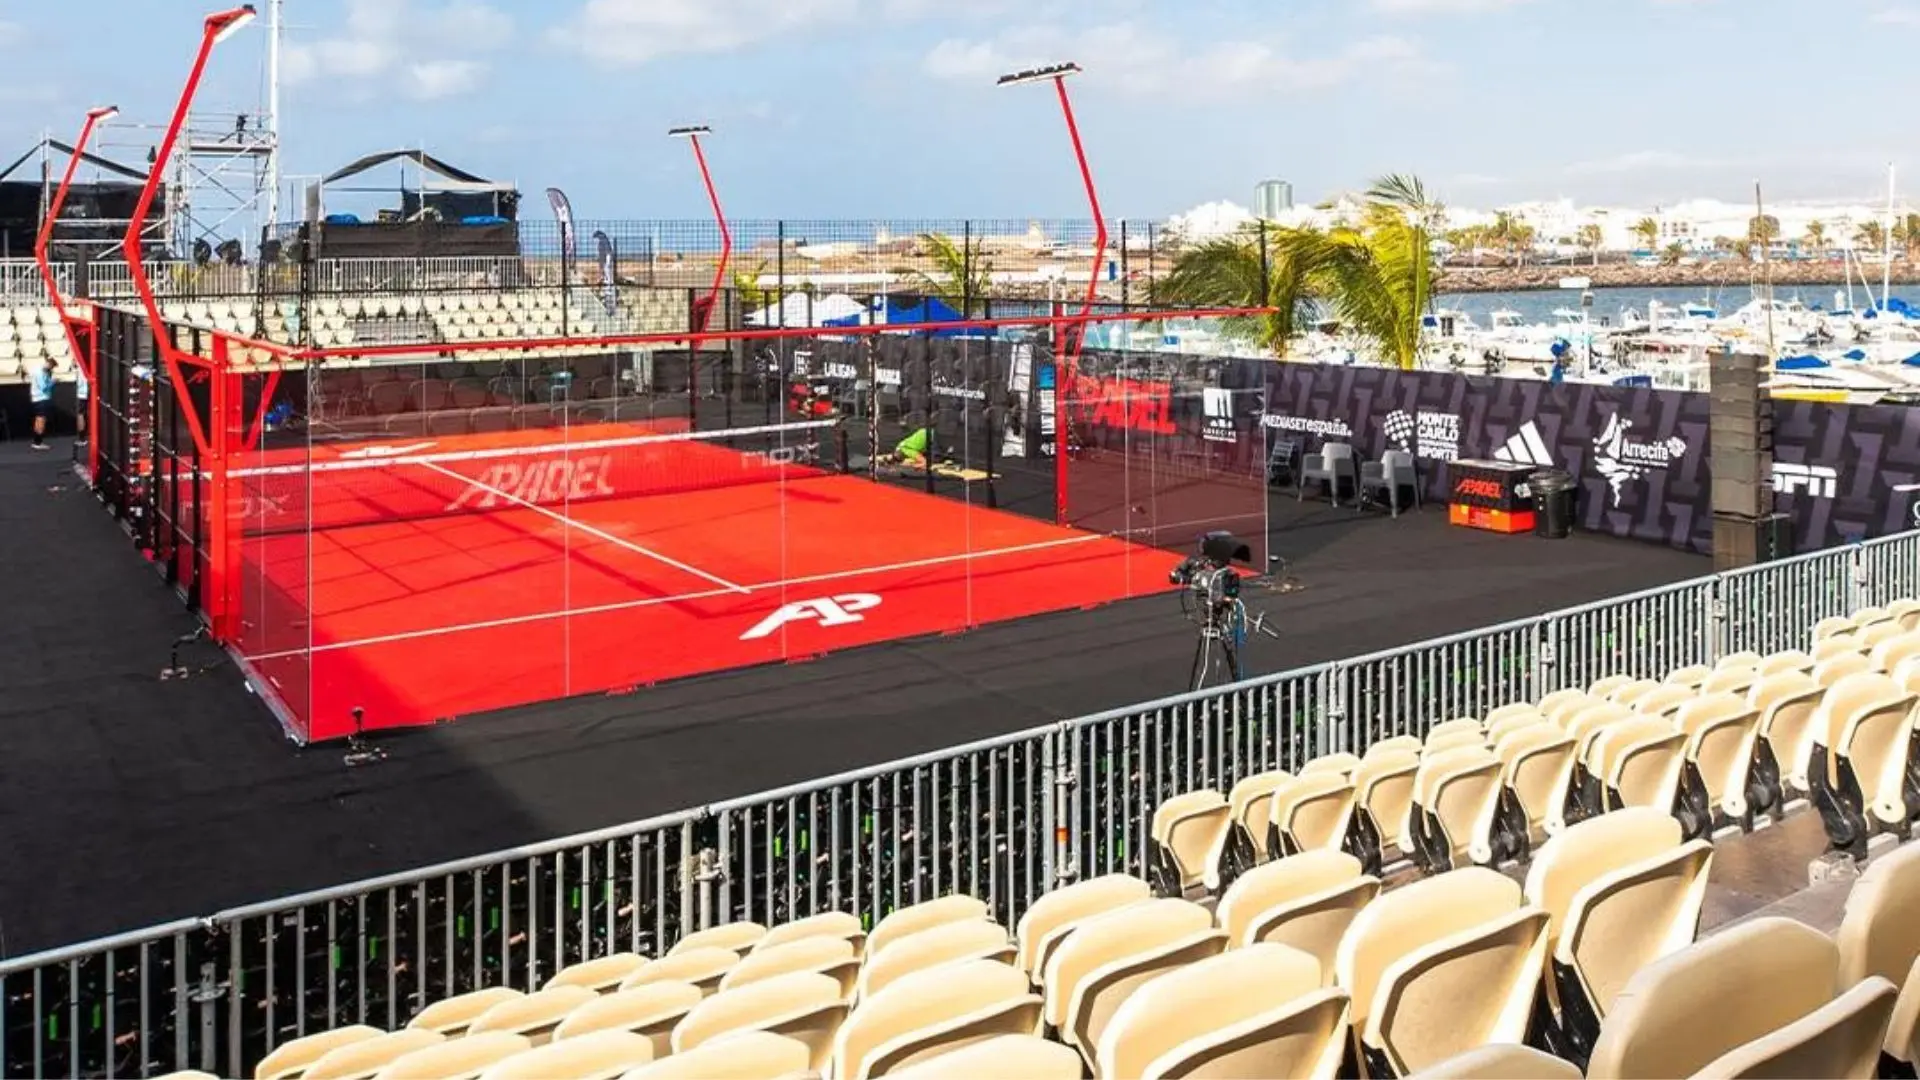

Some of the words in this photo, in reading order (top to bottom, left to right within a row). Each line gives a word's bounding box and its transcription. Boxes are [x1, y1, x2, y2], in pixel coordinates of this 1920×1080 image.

[1416, 411, 1460, 429] MONTE
[1416, 425, 1460, 442] CARLO
[1621, 438, 1669, 461] Arrecife
